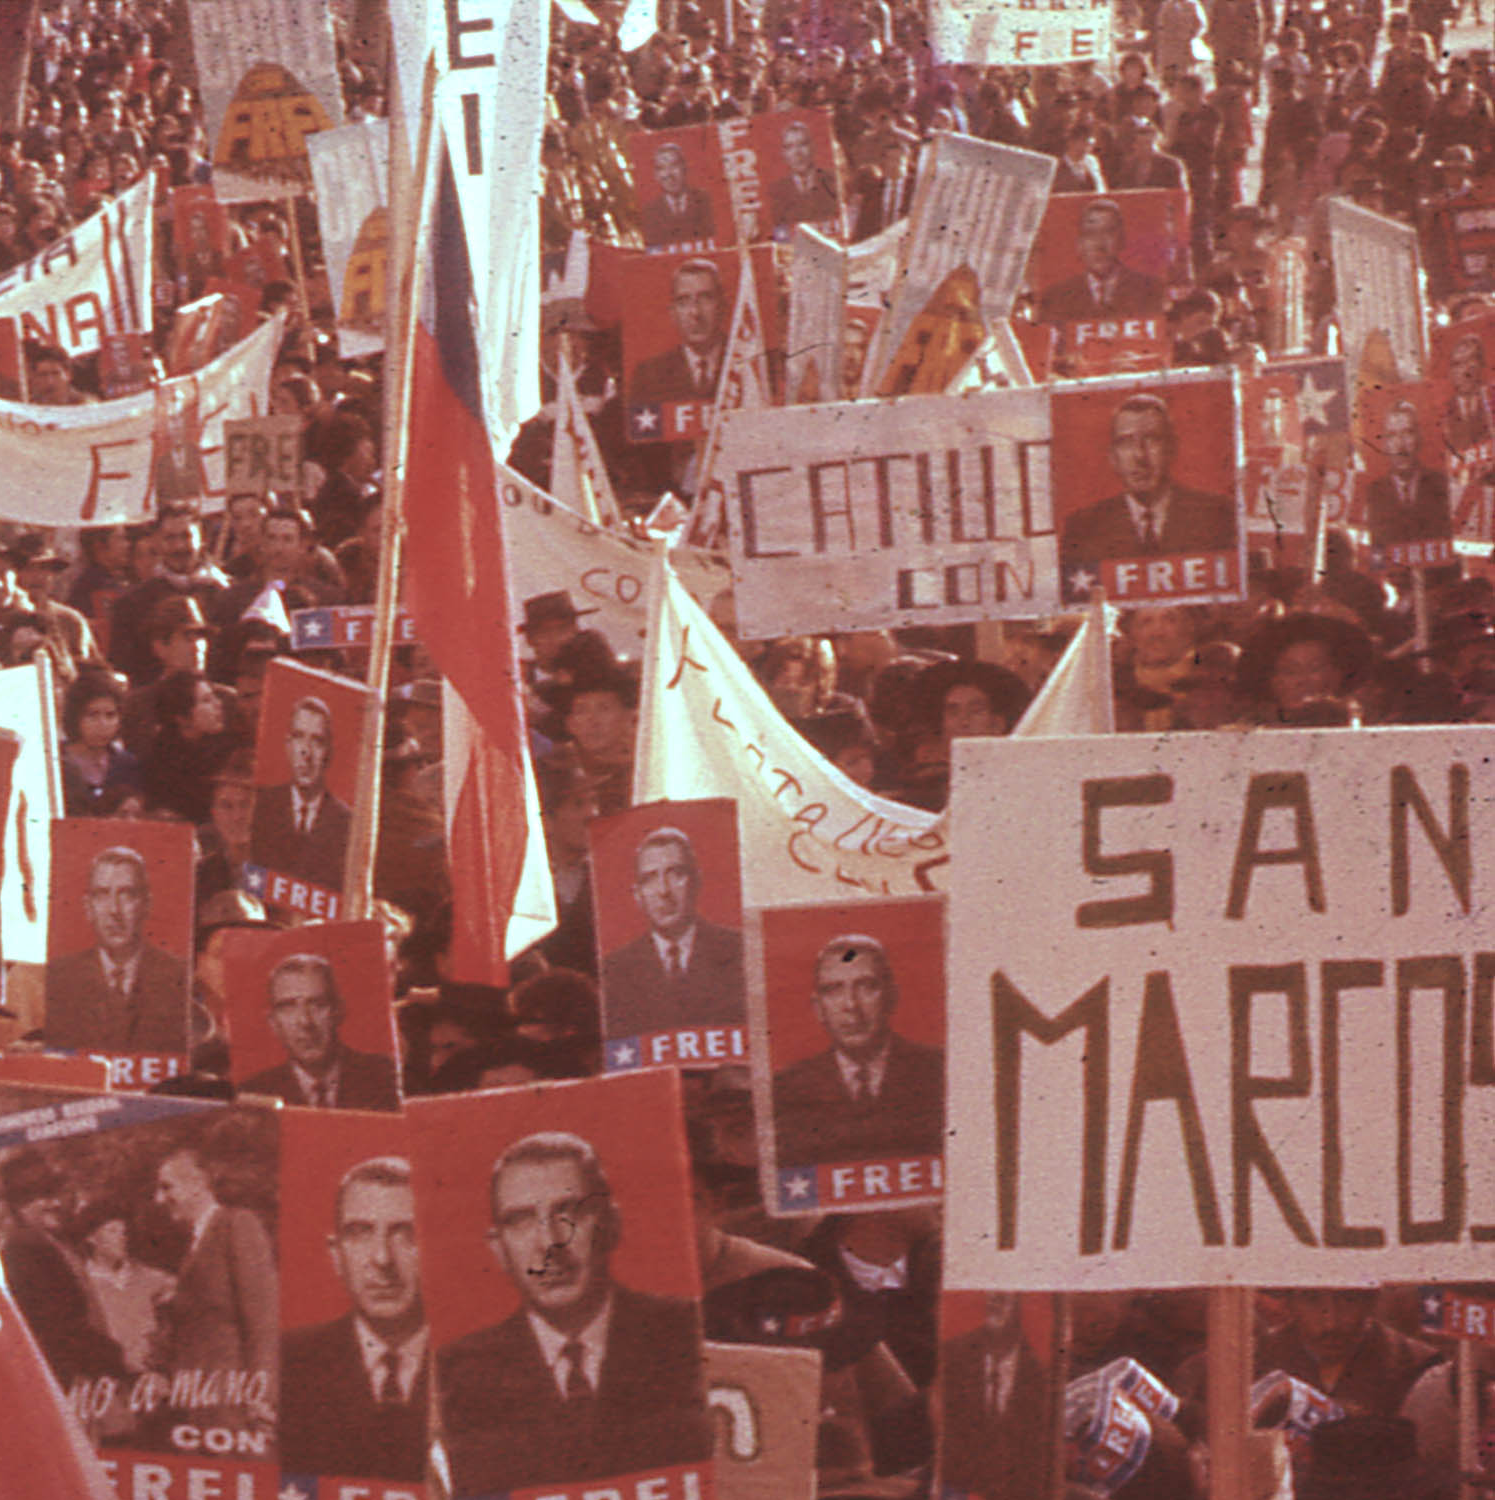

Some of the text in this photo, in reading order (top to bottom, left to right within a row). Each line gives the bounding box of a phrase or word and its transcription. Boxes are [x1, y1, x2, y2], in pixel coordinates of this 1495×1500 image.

[1114, 556, 1230, 594] FREI
[1075, 763, 1473, 933] SAN
[272, 876, 337, 919] FREI
[650, 1029, 745, 1062] FREI
[109, 1057, 178, 1084] REI
[831, 1160, 942, 1200] FREI
[171, 1425, 266, 1454] CON
